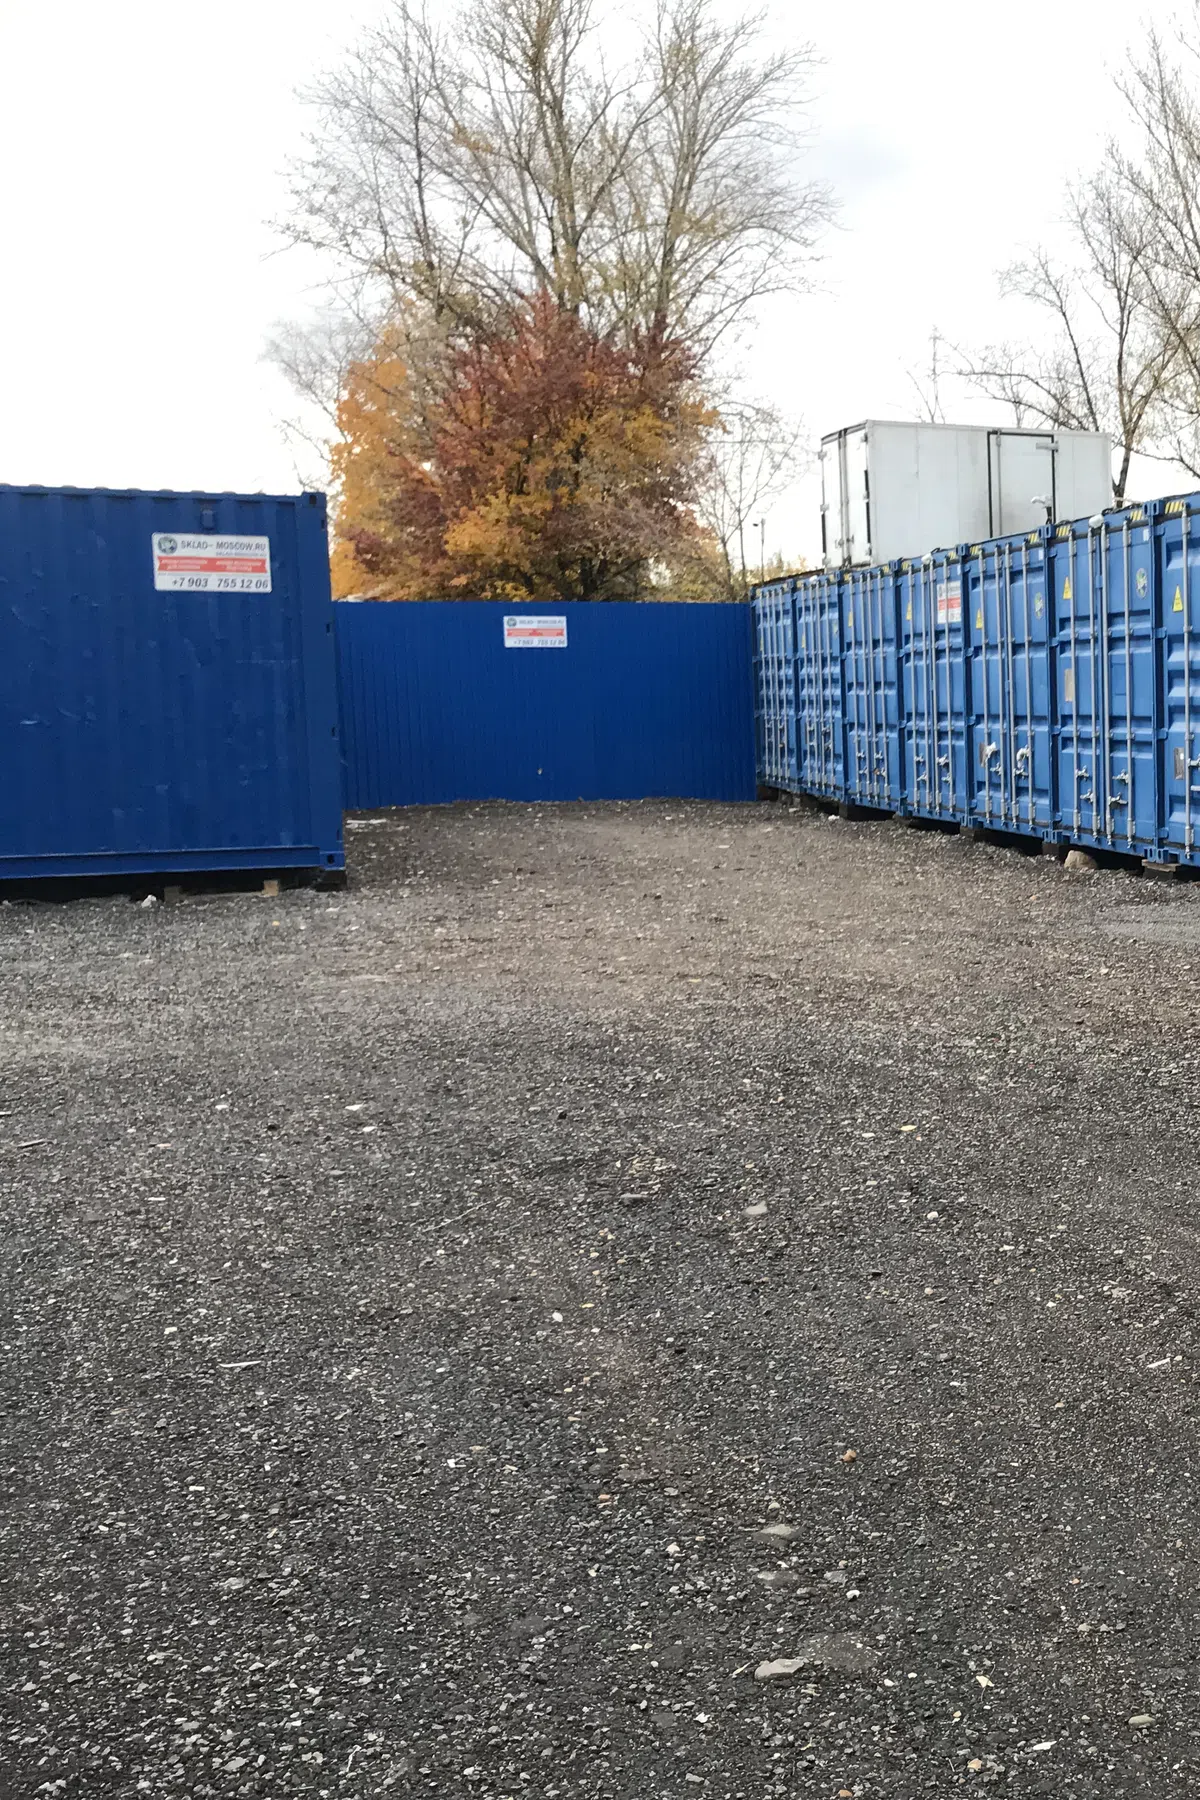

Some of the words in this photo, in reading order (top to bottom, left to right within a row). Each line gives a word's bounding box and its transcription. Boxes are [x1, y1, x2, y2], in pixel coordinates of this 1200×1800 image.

[180, 540, 213, 549] SKLAD-
[216, 541, 266, 551] MOSCOW.RU
[172, 577, 185, 587] +7
[187, 577, 208, 588] 903
[217, 578, 237, 588] 755
[240, 579, 253, 589] 12
[255, 579, 269, 590] 06
